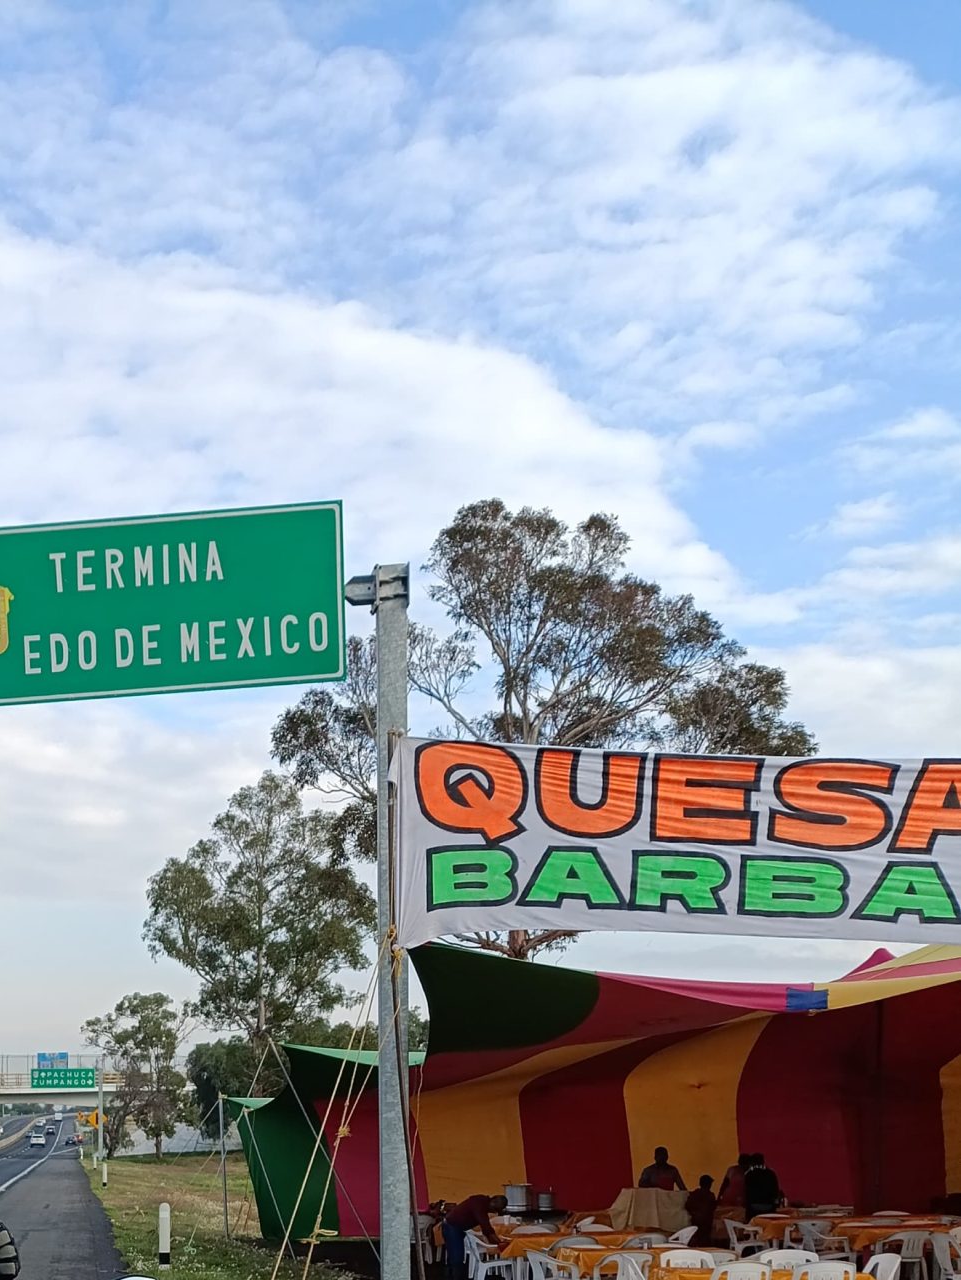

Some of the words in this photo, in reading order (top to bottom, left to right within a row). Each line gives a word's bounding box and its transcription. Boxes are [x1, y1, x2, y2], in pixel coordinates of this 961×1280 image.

[49, 540, 225, 593] TERMINA
[23, 630, 98, 675] EDO
[114, 624, 162, 669] DE
[180, 611, 329, 663] MEXICO
[426, 845, 961, 924] BARBA
[46, 1071, 94, 1079] PACHUCA
